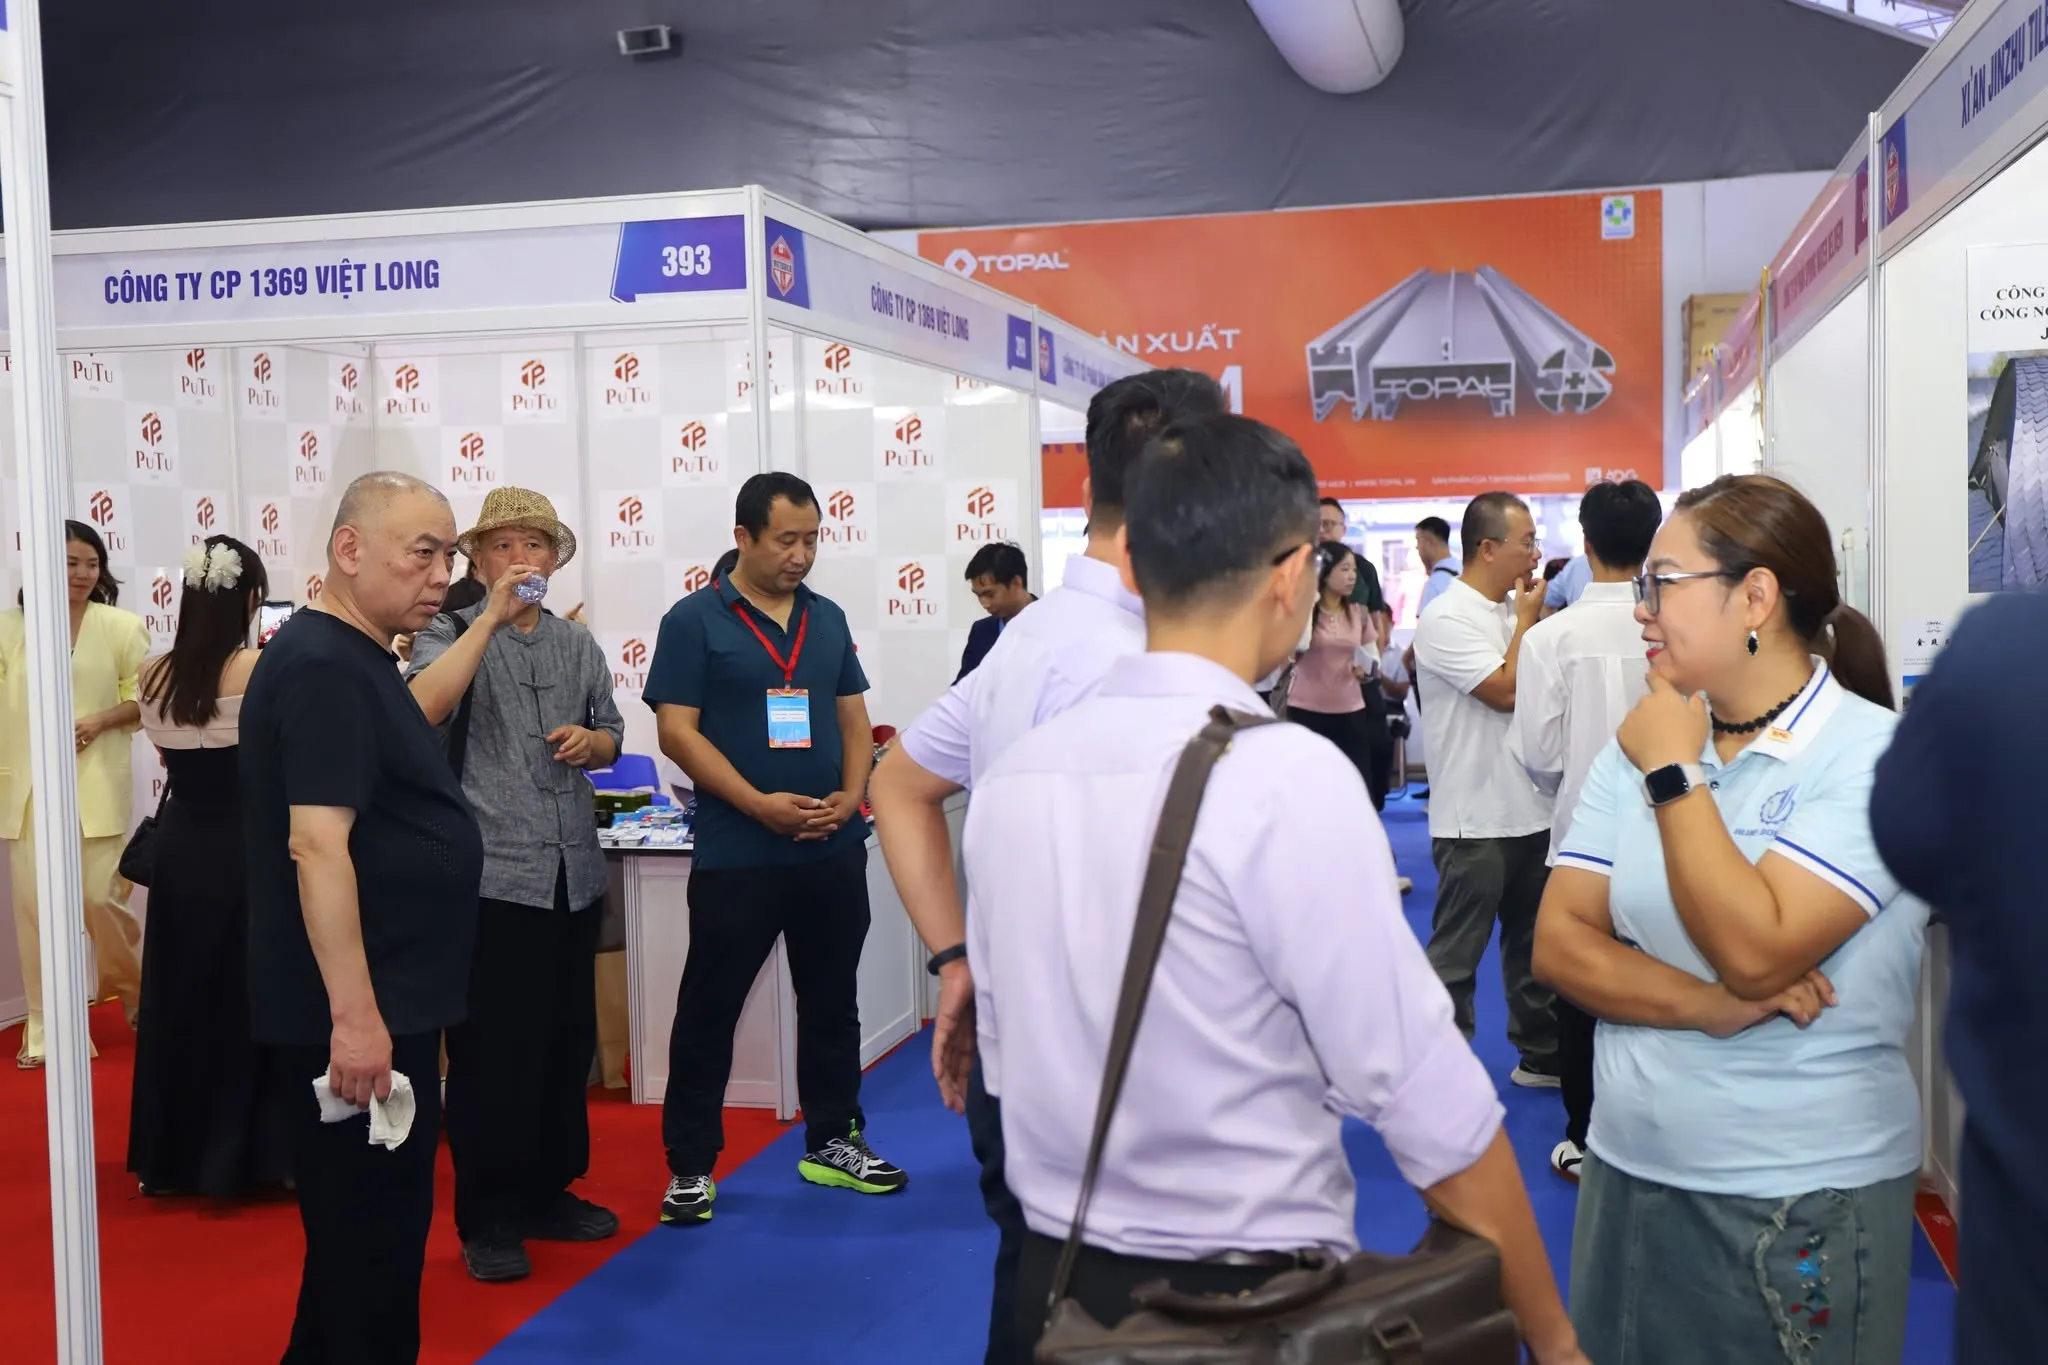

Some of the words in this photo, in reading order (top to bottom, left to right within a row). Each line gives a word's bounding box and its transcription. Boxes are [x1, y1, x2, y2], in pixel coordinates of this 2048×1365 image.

[1988, 22, 2027, 102] JINZHU
[661, 244, 711, 277] 393
[977, 251, 1069, 273] TOPAL
[104, 269, 168, 304] CÔNG
[175, 271, 203, 301] TY
[210, 270, 242, 299] CP
[249, 266, 308, 298] 1369
[315, 258, 367, 299] VIỆT
[374, 259, 440, 291] LONG
[1996, 284, 2045, 301] CÔNG
[871, 281, 894, 317] CÔNG
[894, 293, 904, 320] TY
[906, 297, 916, 323] CP
[917, 303, 935, 331] 1369
[951, 313, 970, 341] LONG
[1980, 305, 2028, 321] CÔNG
[2033, 305, 2048, 318] N
[1145, 323, 1241, 353] XUẤT
